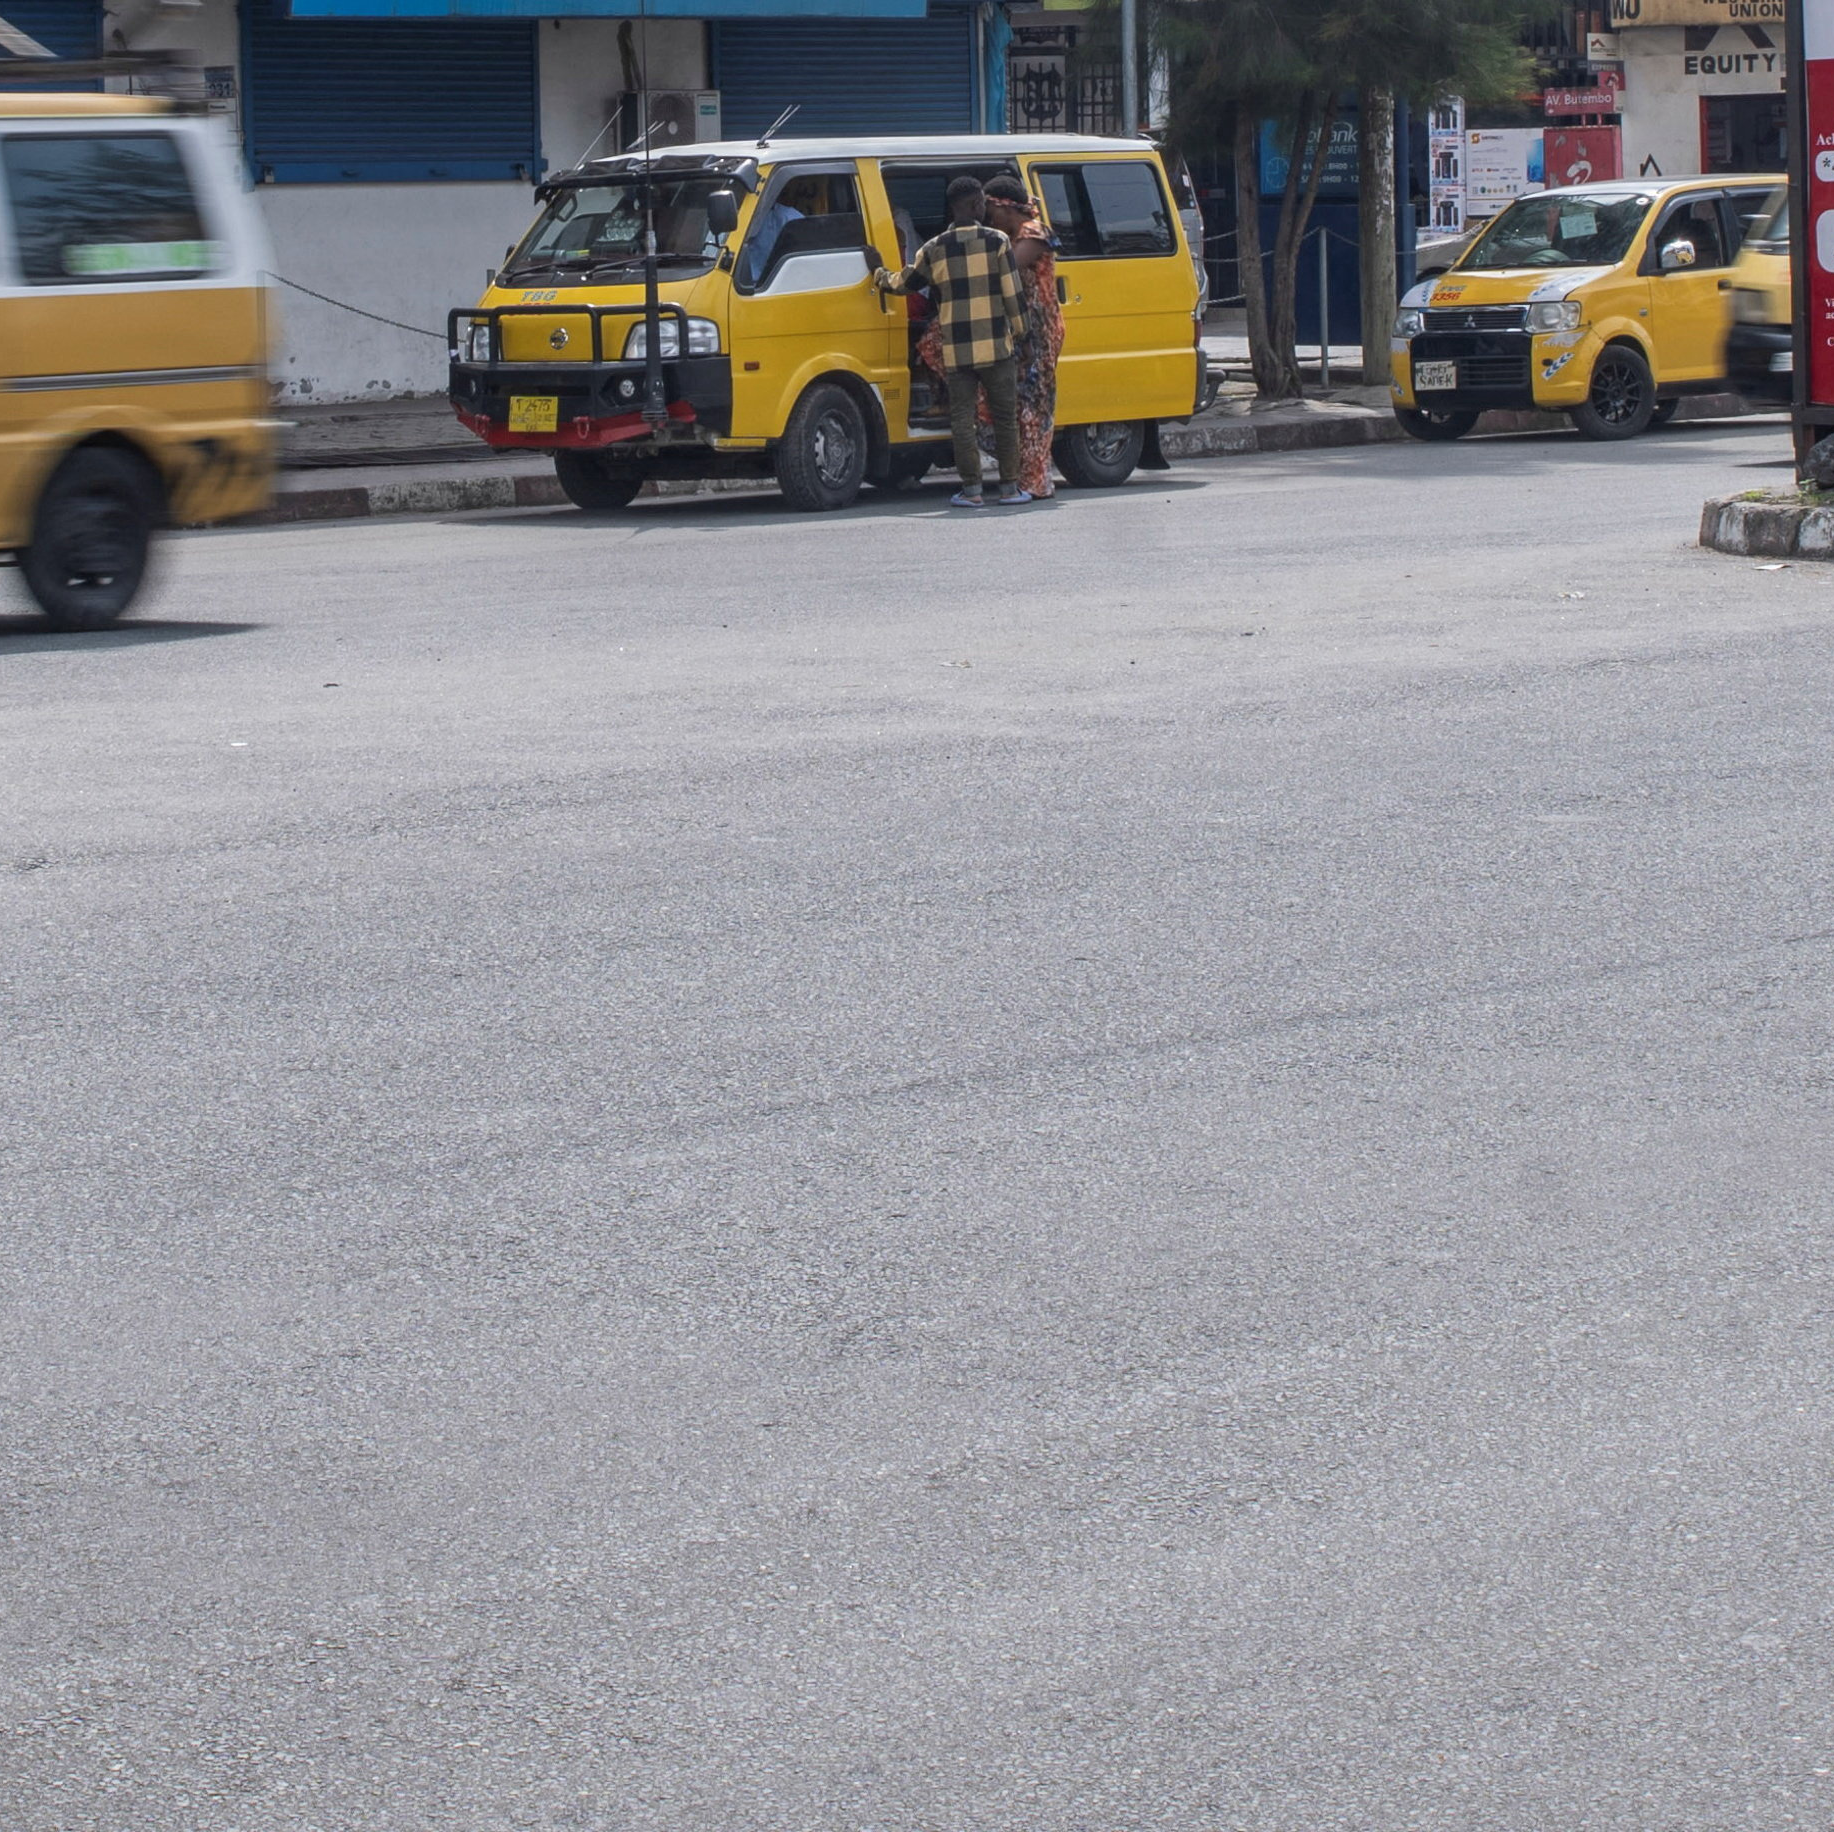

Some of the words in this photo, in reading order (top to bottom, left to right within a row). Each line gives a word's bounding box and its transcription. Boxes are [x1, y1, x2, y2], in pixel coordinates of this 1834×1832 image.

[1729, 4, 1783, 17] UNION
[1684, 53, 1776, 75] EQUITY
[1545, 95, 1562, 107] AV.
[1564, 92, 1612, 105] Butembo
